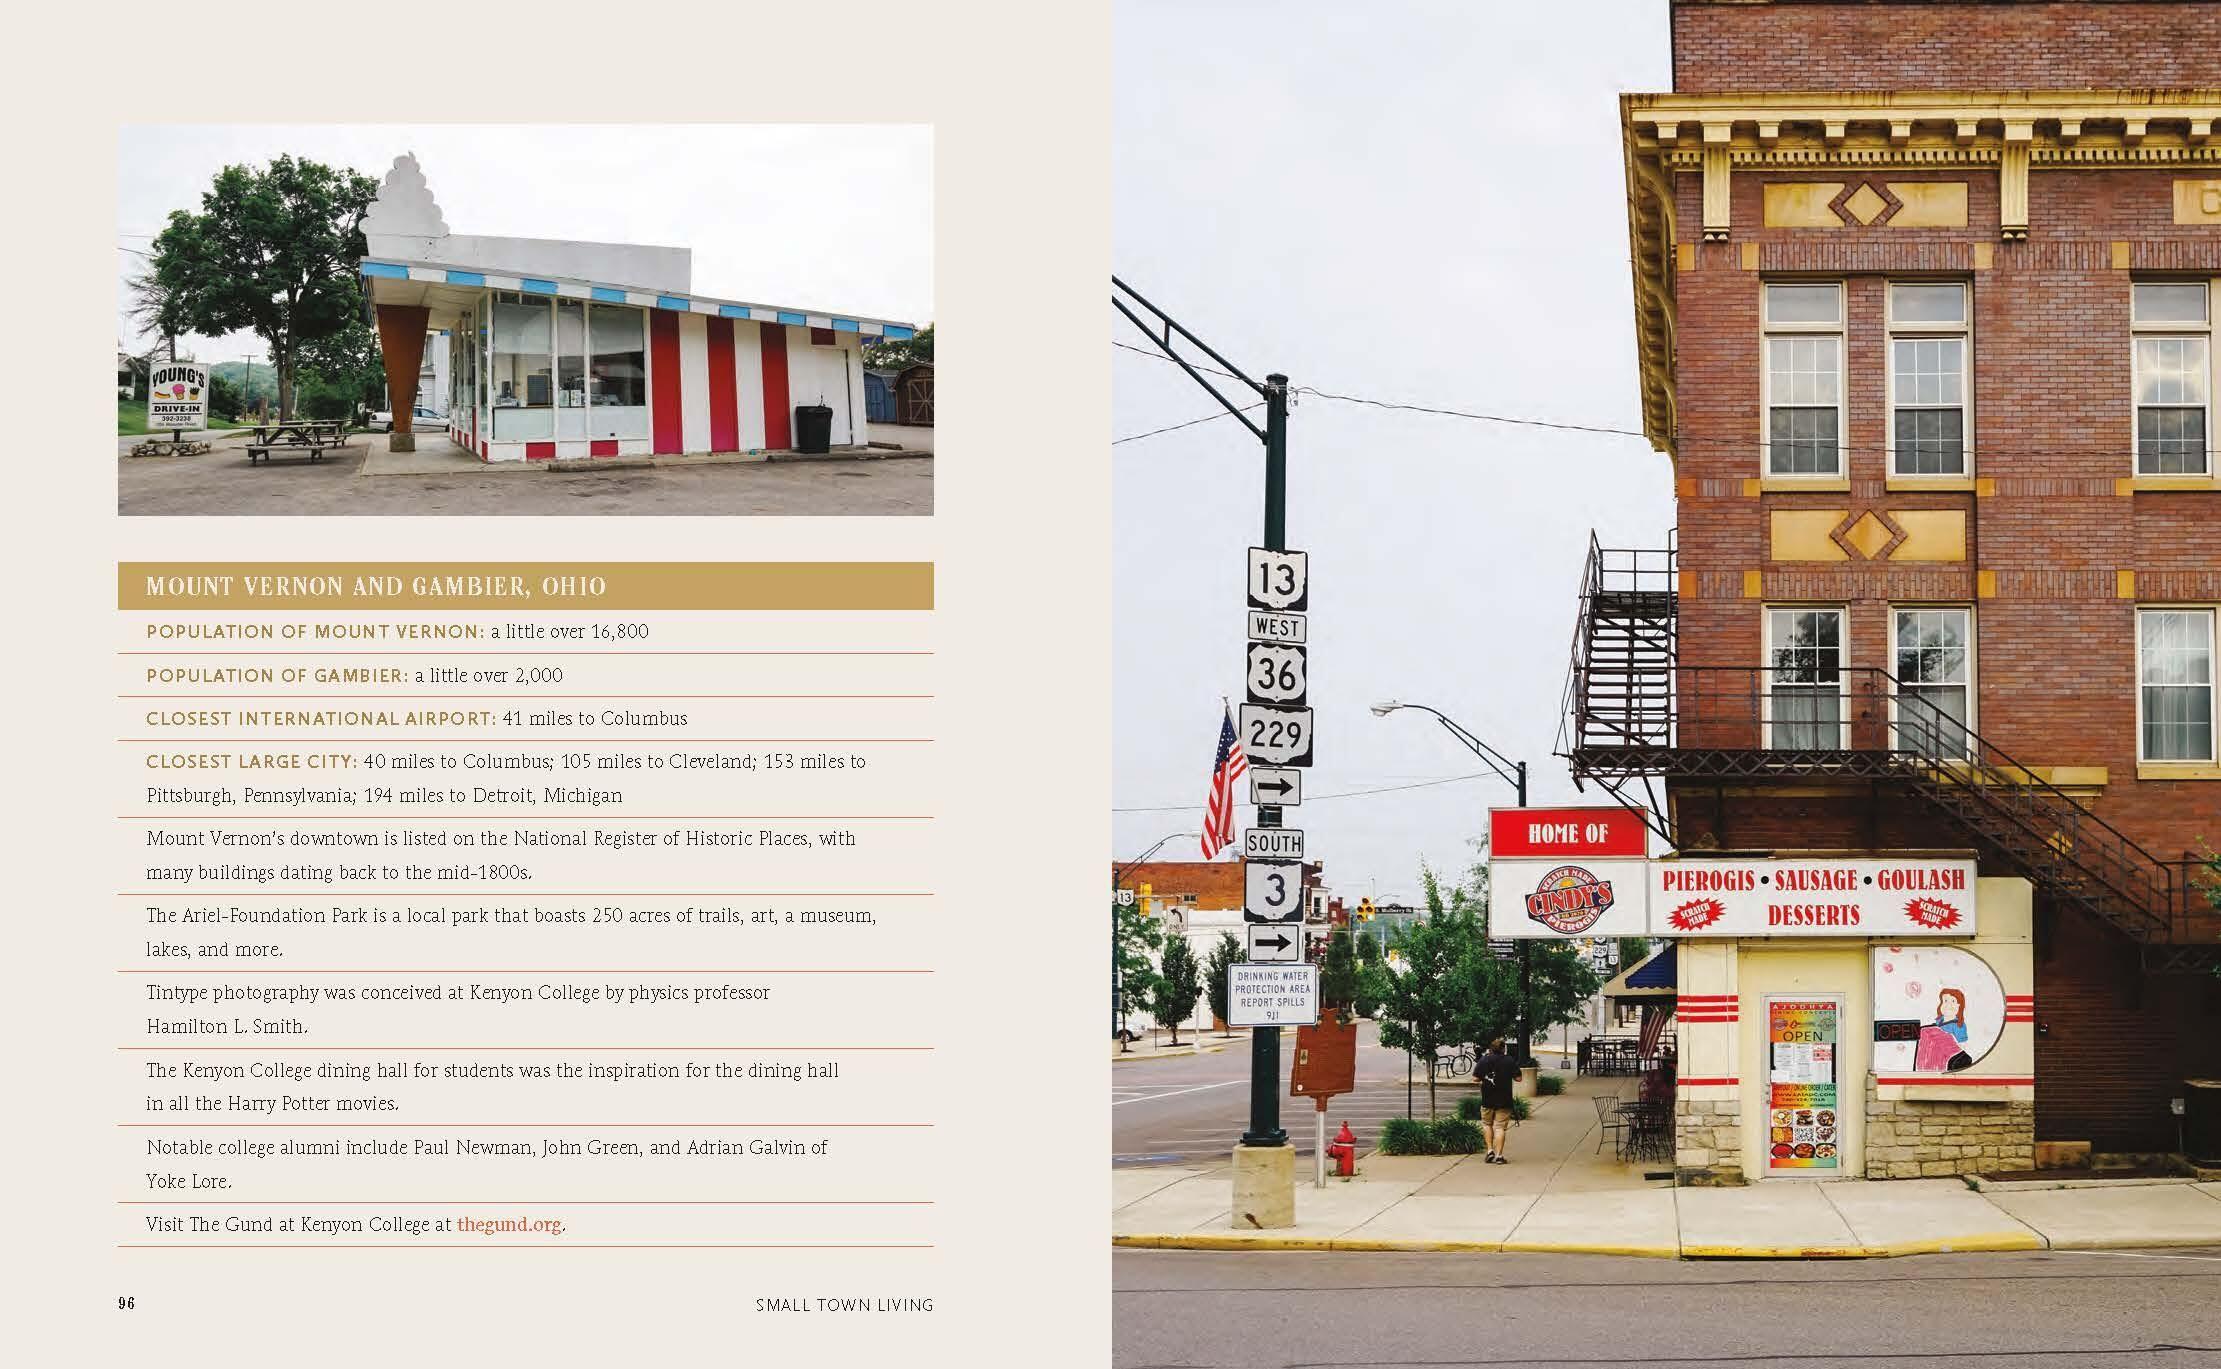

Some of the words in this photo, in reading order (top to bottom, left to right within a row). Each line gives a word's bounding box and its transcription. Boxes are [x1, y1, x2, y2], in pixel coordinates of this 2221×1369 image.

[152, 367, 204, 388] YOUNG'S
[146, 575, 233, 595] MOUNT
[243, 575, 342, 595] VERNON
[352, 575, 402, 595] AND
[412, 575, 530, 599] GAMBIER,
[542, 575, 605, 596] OHIO
[1260, 562, 1295, 596] 13
[147, 623, 272, 640] POPULATION
[279, 623, 306, 640] OF
[314, 623, 389, 639] MOUNT
[395, 623, 483, 639] VERNON:
[491, 627, 500, 638] a
[504, 623, 544, 638] little
[550, 627, 586, 640] over
[591, 623, 648, 642] 16,800
[1256, 617, 1298, 637] WEST
[147, 667, 272, 687] POPULATION
[281, 667, 306, 682] OF
[314, 667, 407, 685] GAMBIER:
[415, 671, 424, 684] a
[429, 666, 467, 686] little
[472, 671, 508, 682] over
[513, 667, 562, 685] 2,000
[1258, 657, 1296, 691] 36
[144, 711, 231, 726] CLOSEST
[239, 711, 399, 726] INTERNATIONAL
[404, 711, 496, 727] AIRPORT:
[501, 709, 522, 725] 41
[528, 709, 572, 725] miles
[578, 711, 594, 725] to
[601, 710, 687, 725] Columbus
[1250, 719, 1301, 749] 229
[146, 753, 231, 768] CLOSEST
[239, 753, 300, 768] LARGE
[306, 753, 356, 768] CITY:
[362, 753, 385, 768] 40
[391, 751, 436, 767] miles
[440, 751, 457, 767] to
[462, 751, 554, 771] Columbus;
[560, 751, 591, 767] 105
[596, 751, 642, 767] miles
[646, 751, 663, 767] to
[669, 751, 757, 771] Cleveland;
[763, 751, 795, 767] 153
[800, 751, 844, 767] miles
[849, 751, 866, 767] to
[145, 784, 235, 806] Pittsburgh,
[240, 787, 360, 808] Pennsylvania;
[364, 787, 392, 802] 194
[399, 787, 443, 802] miles
[448, 788, 465, 804] to
[472, 783, 535, 805] Detroit,
[543, 787, 622, 808] Michigan
[146, 830, 206, 846] Mount
[209, 829, 284, 845] Vernon's
[290, 830, 378, 848] downtown
[384, 829, 399, 845] is
[403, 829, 446, 845] listed
[451, 832, 474, 846] on
[480, 830, 507, 845] the
[513, 829, 586, 847] National
[593, 830, 658, 849] Register
[663, 830, 680, 845] of
[685, 829, 752, 847] Historic
[759, 830, 811, 848] Places,
[818, 829, 855, 846] with
[1248, 834, 1301, 853] SOUTH
[1528, 823, 1579, 844] HOME
[1586, 823, 1608, 844] OF
[144, 863, 193, 884] many
[197, 863, 275, 883] buildings
[279, 863, 332, 883] dating
[339, 863, 376, 879] back
[381, 863, 399, 879] to
[402, 863, 431, 879] the
[436, 863, 532, 879] mid-1800s.
[1663, 869, 1755, 892] PIEROGIS
[1775, 869, 1858, 892] SAUSAGE
[1877, 869, 1965, 891] GOULASH
[1120, 892, 1131, 903] 13
[1265, 873, 1286, 907] 3
[1527, 882, 1612, 917] CINDY'S
[146, 907, 176, 927] The
[181, 907, 326, 922] Ariel-Foundation
[330, 907, 368, 922] Park
[371, 907, 386, 922] is
[391, 912, 401, 922] a
[406, 907, 446, 922] local
[451, 907, 488, 927] park
[493, 907, 528, 922] that
[533, 907, 585, 922] boasts
[591, 907, 624, 922] 250
[628, 912, 670, 922] acres
[675, 907, 693, 922] of
[698, 907, 744, 927] trails,
[750, 907, 777, 927] art,
[784, 912, 794, 922] a
[800, 912, 876, 927] museum,
[1547, 908, 1598, 931] PIEROGIS
[1680, 902, 1710, 920] SCRATCH
[1688, 912, 1709, 926] MADE
[1768, 904, 1860, 927] DESSERTS
[1919, 901, 1949, 918] SCRATCH
[1921, 912, 1942, 924] MADE
[1238, 971, 1280, 982] DRINKING
[1282, 972, 1308, 982] WATER
[146, 984, 207, 1003] Tintype
[212, 983, 319, 1003] photography
[323, 983, 356, 999] was
[361, 984, 442, 999] conceived
[448, 985, 463, 999] at
[469, 984, 532, 1003] Kenyon
[537, 984, 599, 1003] College
[604, 984, 624, 1003] by
[628, 984, 688, 1005] physics
[692, 984, 771, 1003] professor
[1235, 984, 1286, 995] PROTECTION
[1290, 984, 1311, 994] AREA
[1240, 997, 1274, 1008] REPORT
[1278, 997, 1305, 1007] SPILLS
[1783, 1031, 1823, 1042] OPEN
[145, 1215, 183, 1231] Visit
[189, 1216, 222, 1231] The
[225, 1215, 272, 1231] Gund
[279, 1215, 294, 1231] at
[300, 1216, 363, 1235] Kenyon
[369, 1216, 429, 1235] College
[435, 1217, 452, 1231] at
[456, 1215, 565, 1235] thegund.org.
[118, 1296, 134, 1312] 96
[756, 1297, 810, 1311] SMALL
[816, 1295, 869, 1311] TOWN
[878, 1297, 932, 1311] LIVING
